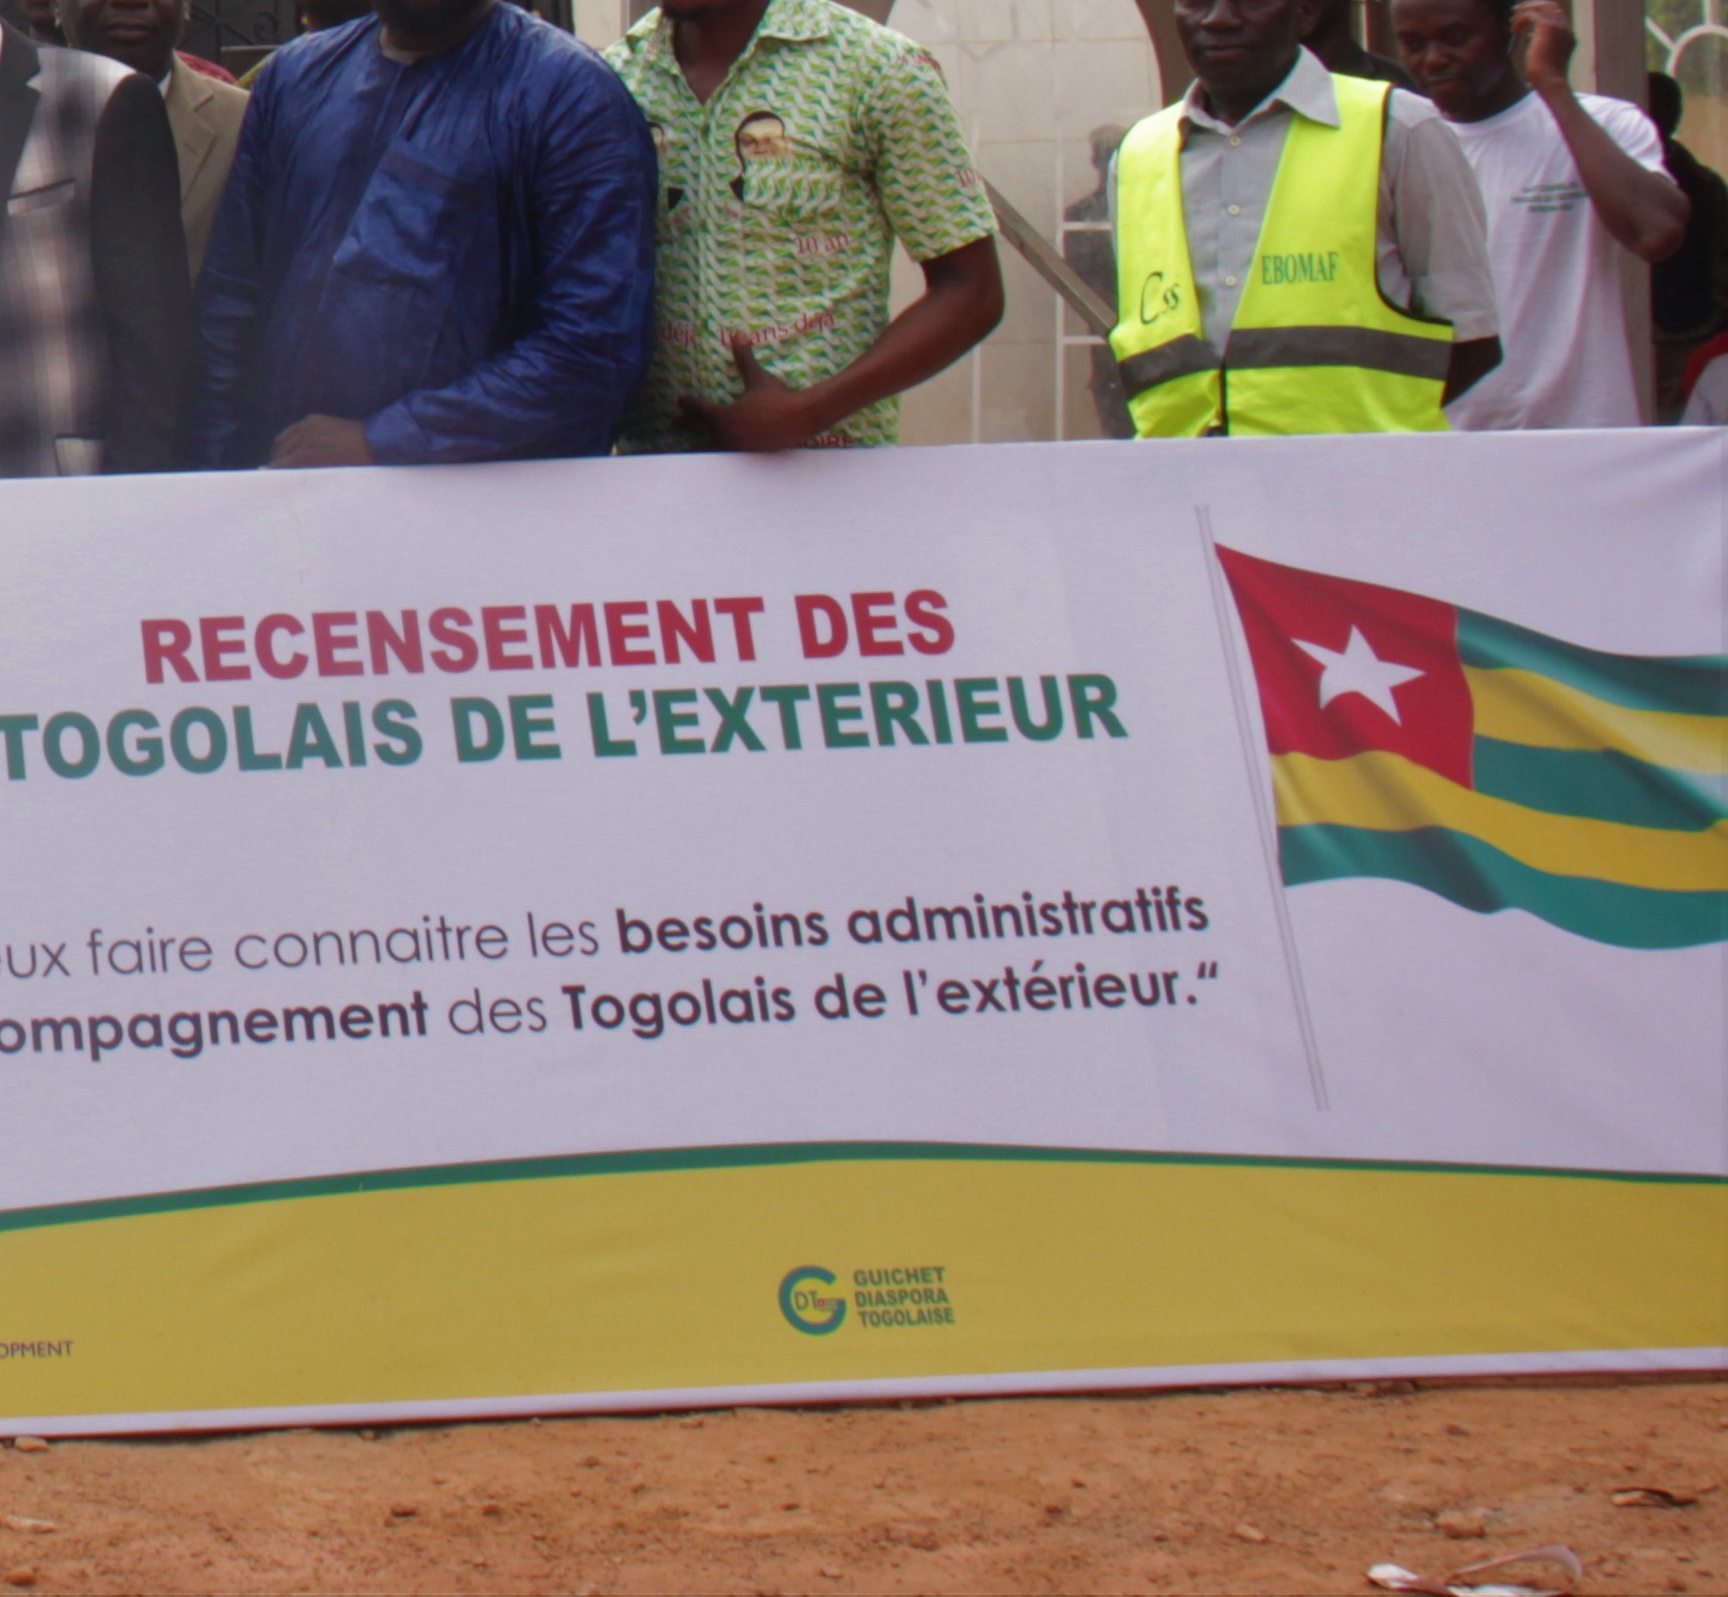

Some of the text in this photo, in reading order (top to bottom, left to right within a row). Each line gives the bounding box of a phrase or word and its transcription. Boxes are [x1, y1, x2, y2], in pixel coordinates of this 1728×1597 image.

[1262, 251, 1338, 285] EBOMAF
[141, 589, 954, 684] RECENSEMENT DES
[450, 694, 561, 763] DE
[586, 674, 1128, 757] L'EXTERIEUR
[87, 927, 212, 975] faire
[235, 915, 508, 969] connaitre
[527, 912, 599, 957] les
[616, 902, 828, 953] besoins
[848, 886, 1208, 944] administratifs
[448, 988, 547, 1035] des
[562, 976, 795, 1039] Togolais
[814, 973, 886, 1020] de
[854, 1267, 945, 1287] GUICHET
[855, 1289, 949, 1308] DIASPORA
[858, 1307, 955, 1328] TOGOLAISE
